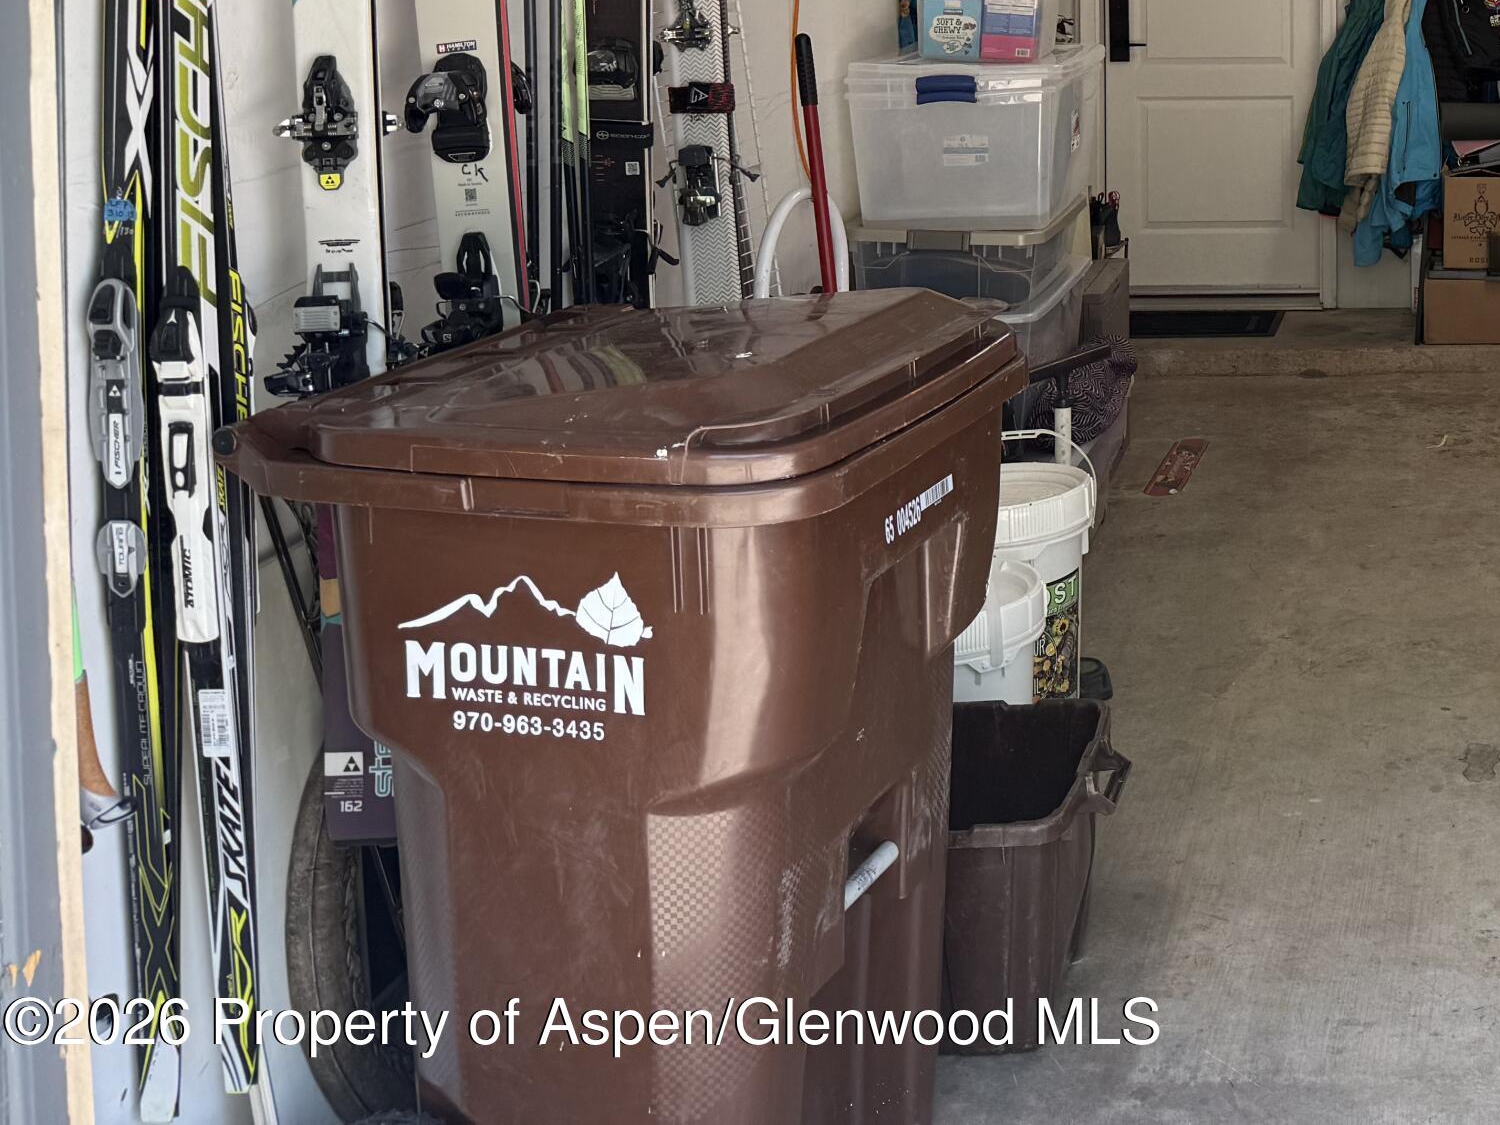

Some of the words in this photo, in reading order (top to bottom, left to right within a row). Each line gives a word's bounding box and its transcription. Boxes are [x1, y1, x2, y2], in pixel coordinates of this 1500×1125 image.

[933, 26, 961, 34] CHEWY
[936, 18, 954, 26] SOFT
[446, 40, 476, 50] HAMILTON
[228, 270, 249, 421] FISCHE
[113, 418, 121, 469] FISCHER
[218, 463, 227, 509] SKATE
[884, 514, 895, 545] 65
[895, 494, 922, 537] 004526
[405, 640, 646, 716] MOUNTAIN
[451, 686, 503, 704] WASTE
[507, 691, 518, 705] &
[523, 692, 607, 712] RECYCLING
[452, 710, 605, 741] 970-963-3435
[340, 799, 363, 813] 162
[216, 755, 250, 902] SKATE
